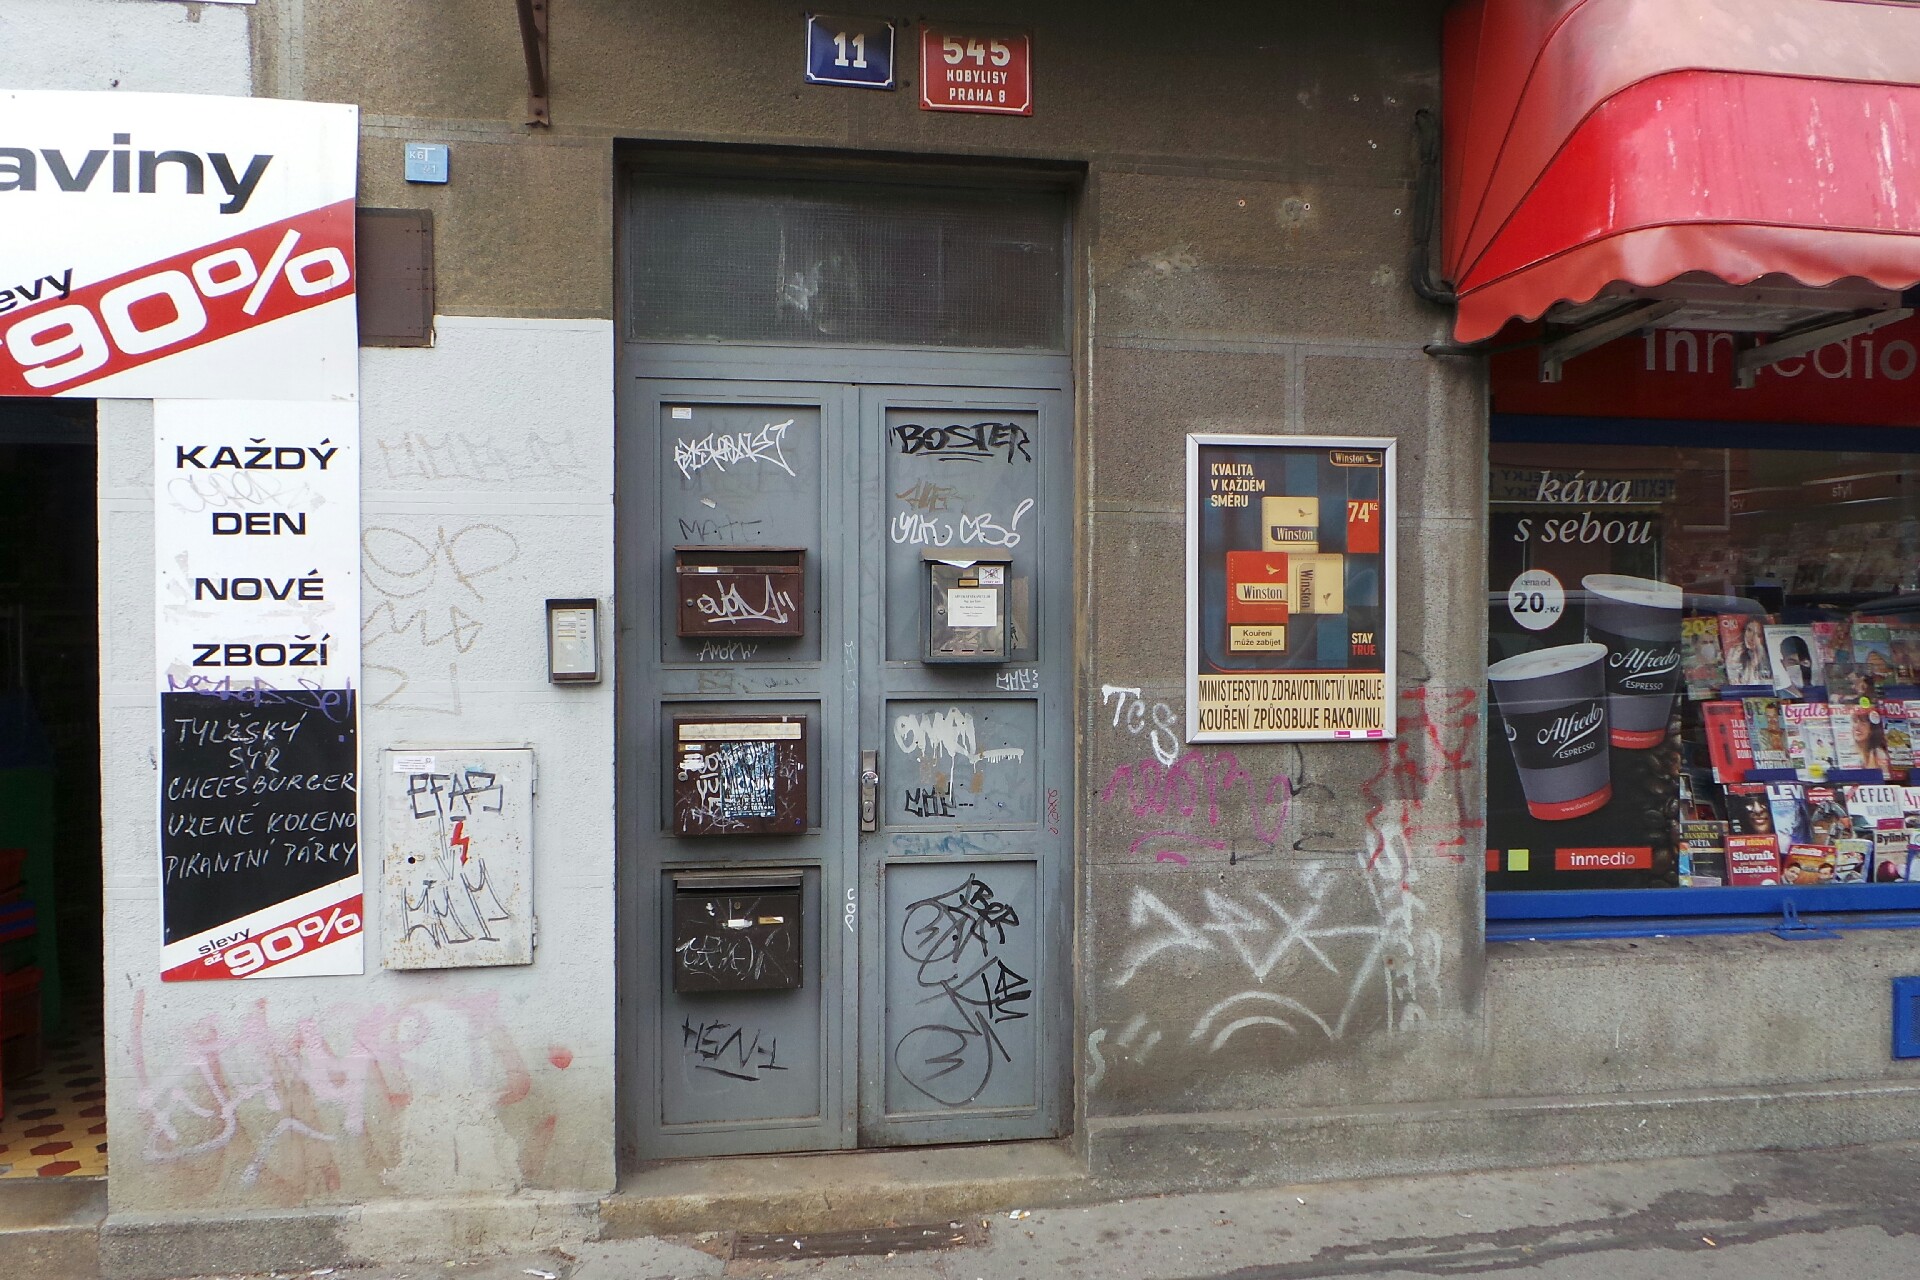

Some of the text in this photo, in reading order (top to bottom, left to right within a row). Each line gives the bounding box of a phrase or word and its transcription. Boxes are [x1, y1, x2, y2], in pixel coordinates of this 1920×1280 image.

[833, 31, 868, 69] 11
[943, 33, 1011, 66] 545
[949, 87, 1006, 103] PRAHA 8
[5, 228, 352, 389] 90%
[176, 437, 339, 470] KAŽDÝ
[1335, 452, 1365, 464] Winston
[1211, 463, 1254, 476] KVALITA
[1210, 476, 1266, 492] V KAŽDÉM
[1536, 470, 1632, 503] káva
[1210, 492, 1249, 507] SMĚRU
[1348, 501, 1370, 523] 74
[212, 512, 306, 536] DEN
[1276, 527, 1314, 541] Winston
[1514, 510, 1652, 544] s sebou
[195, 568, 324, 601] NOVÉ
[1243, 584, 1283, 600] Winston
[1300, 569, 1314, 609] Winston
[1540, 577, 1551, 587] od
[1234, 638, 1282, 647] může zabíjet
[1242, 629, 1273, 637] Kouření
[1351, 632, 1374, 645] STAY
[192, 633, 331, 667] ZBOŽÍ
[1351, 644, 1376, 656] TRUE
[1609, 647, 1681, 674] Alfredo
[1199, 675, 1385, 702] MINISTERSTVO ZDRAVOTNICTVÍ VARUJE:
[1625, 680, 1664, 690] ESPRESSO
[1199, 703, 1384, 731] KOUŘENÍ ZPŮSOBUJE RAKOVINU.
[1537, 702, 1604, 745] Alfredo
[1559, 741, 1596, 759] ESPRESSO
[168, 773, 357, 801] CHEESBURGER
[266, 811, 357, 834] KOLENO
[1688, 838, 1711, 847] SVĚTA
[164, 837, 357, 885] PIKANTNÍ PÁRKY
[1570, 852, 1635, 867] inmedio
[1732, 850, 1776, 861] Slovník
[198, 928, 251, 955] slevy
[223, 907, 361, 977] 90%
[204, 951, 224, 967] až
